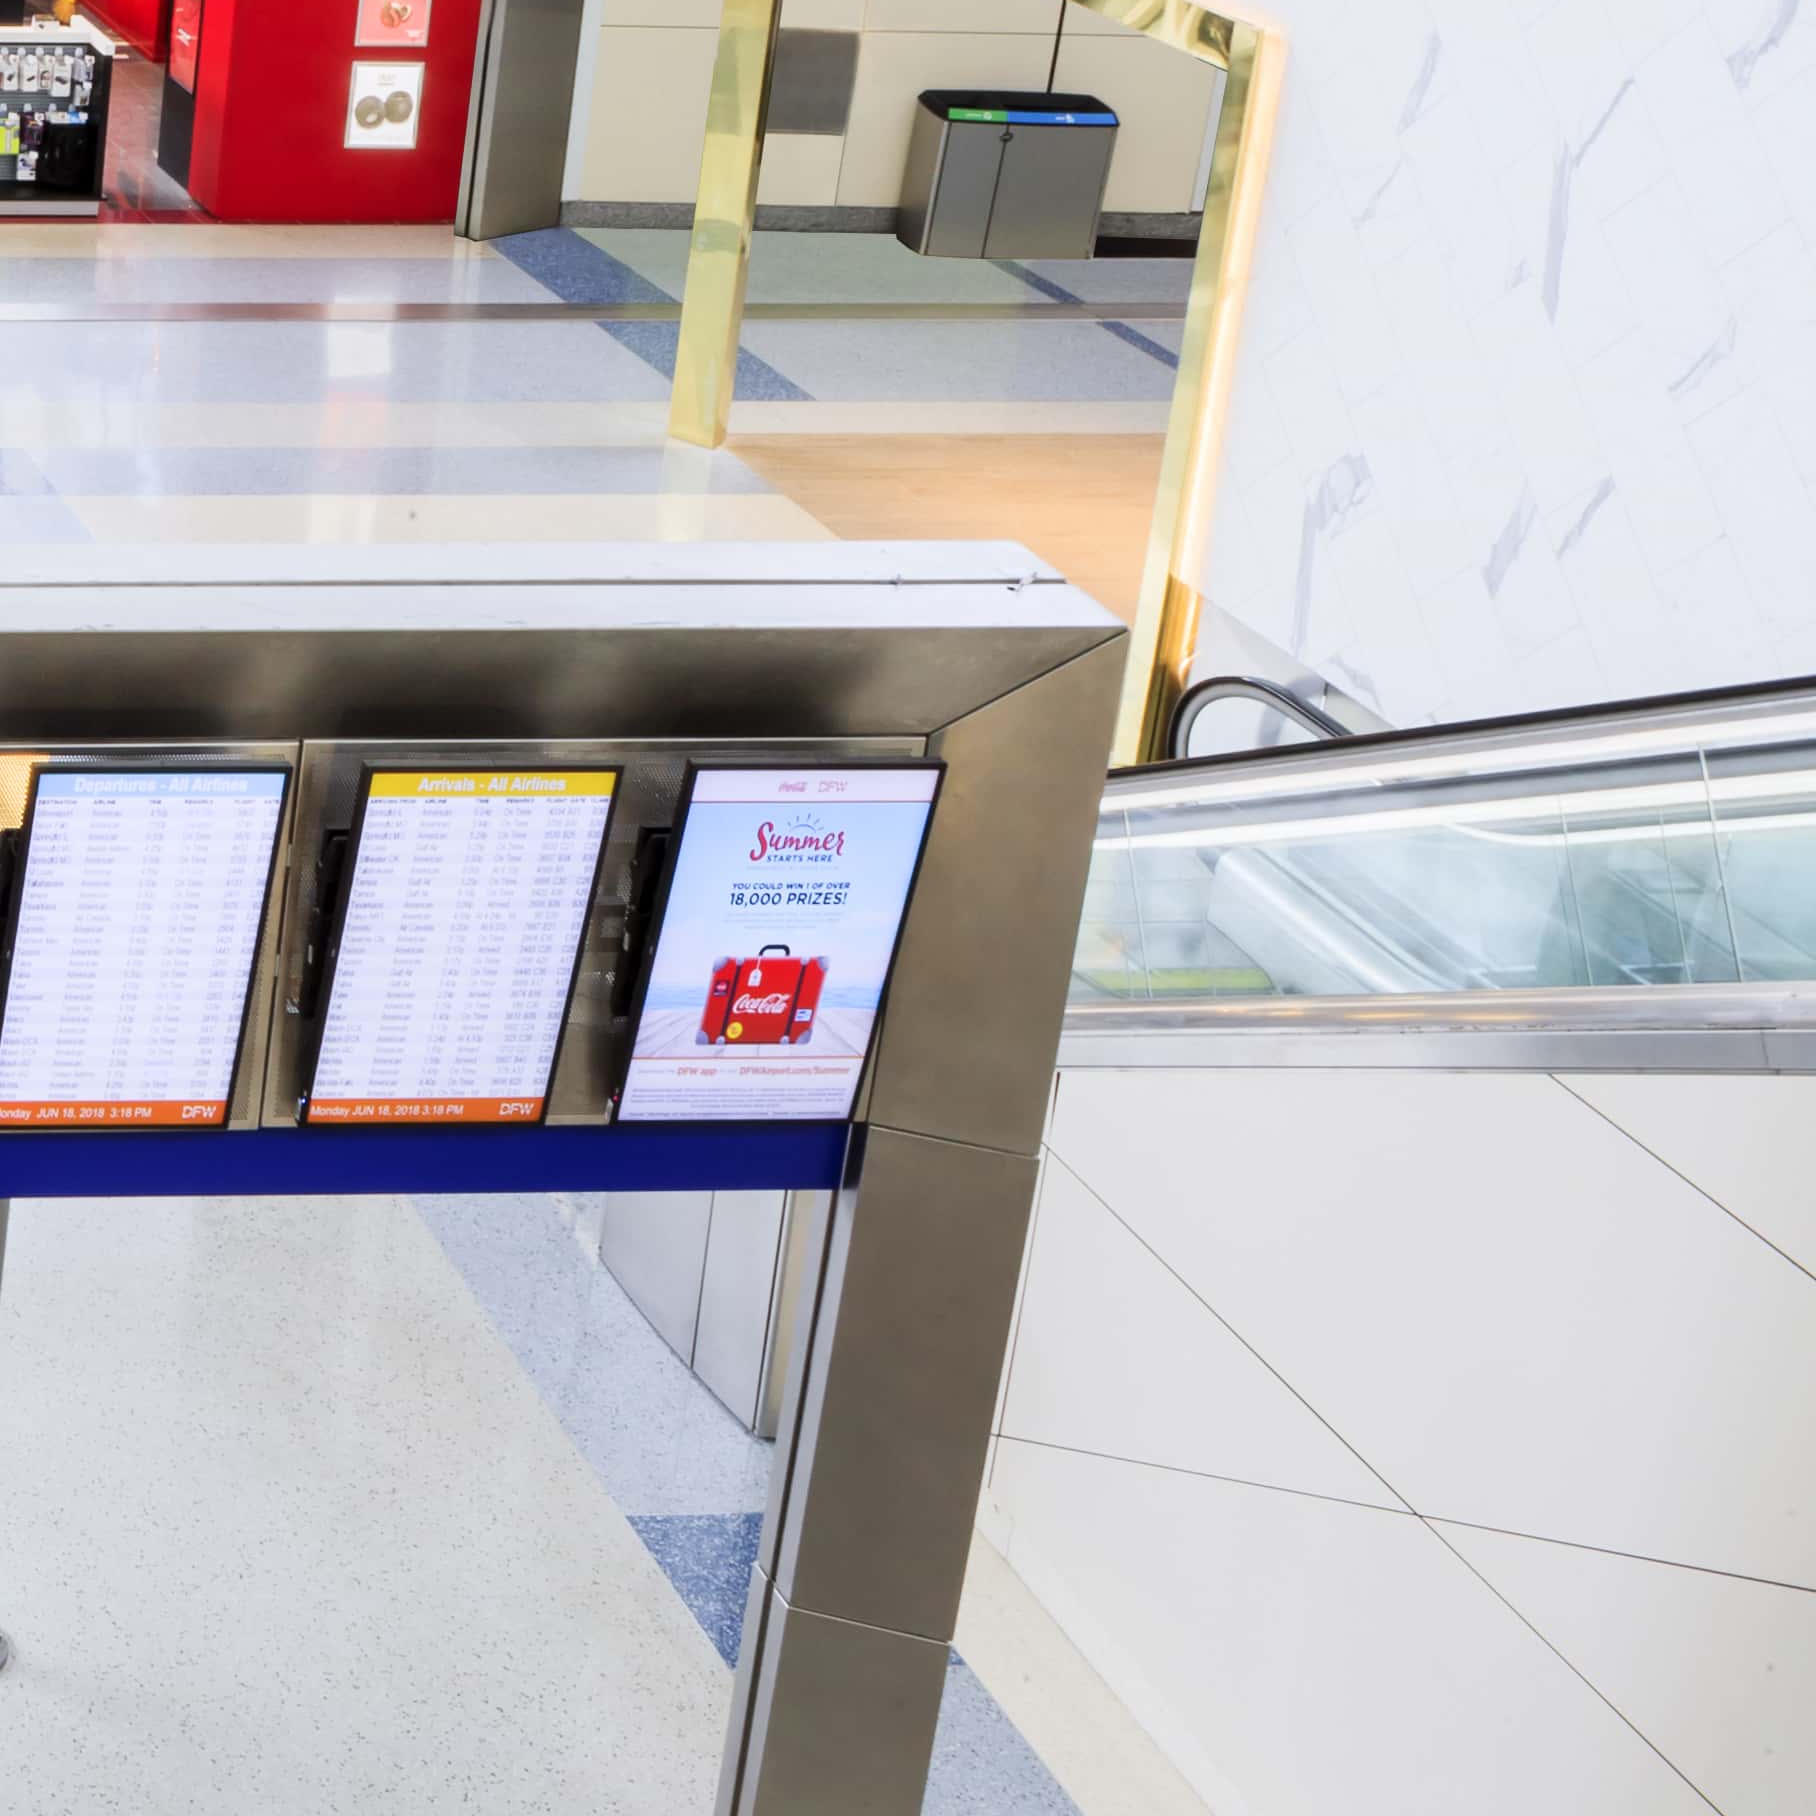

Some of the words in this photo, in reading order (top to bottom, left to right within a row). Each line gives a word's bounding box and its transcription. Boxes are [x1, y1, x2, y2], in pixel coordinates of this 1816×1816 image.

[74, 778, 155, 794] Departures
[168, 778, 187, 792] All
[192, 778, 248, 792] Airlines
[418, 778, 474, 792] Arrivals
[488, 777, 507, 791] All
[512, 777, 566, 791] Airlines
[749, 821, 845, 862] Summer
[766, 854, 803, 863] STARTS
[807, 854, 833, 863] HERE
[732, 882, 751, 890] YOU
[752, 882, 783, 890] COULD
[786, 882, 804, 890] WIN
[812, 882, 824, 890] OF
[826, 882, 851, 890] OVER
[730, 892, 782, 908] 18,000
[786, 892, 848, 905] PRIZES!
[37, 1108, 59, 1119] JUN
[79, 1107, 105, 1118] 2018
[110, 1107, 132, 1118] 3:18
[134, 1107, 152, 1118] PM
[181, 1105, 217, 1119] DFW
[310, 1106, 350, 1118] Monday
[352, 1105, 375, 1117] JUN
[394, 1105, 420, 1116] 2018
[422, 1105, 445, 1116] 3:18
[446, 1104, 465, 1115] PM
[499, 1102, 534, 1116] DFW
